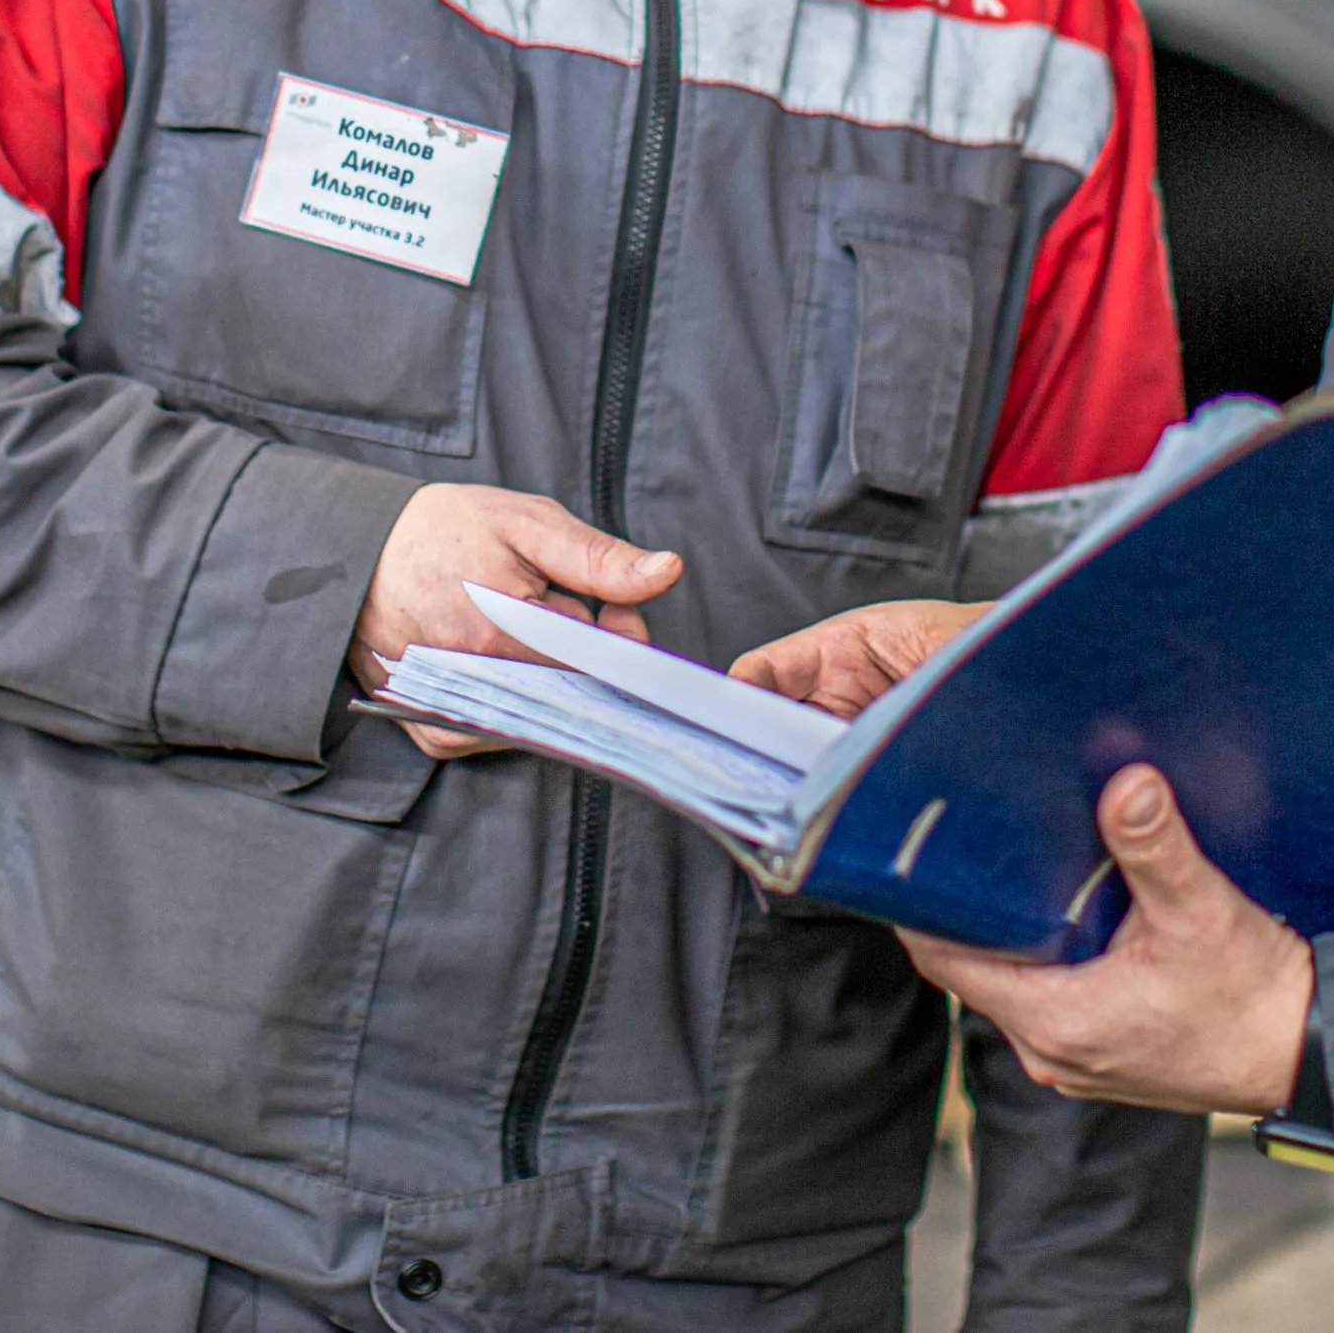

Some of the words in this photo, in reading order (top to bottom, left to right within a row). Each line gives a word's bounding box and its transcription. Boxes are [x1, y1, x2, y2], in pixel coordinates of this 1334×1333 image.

[338, 118, 435, 160] Комалов
[341, 150, 415, 188] Динар
[311, 169, 432, 219] Ильясович
[300, 203, 346, 227] Мастер
[349, 219, 401, 241] участка
[404, 233, 426, 248] 3.2
